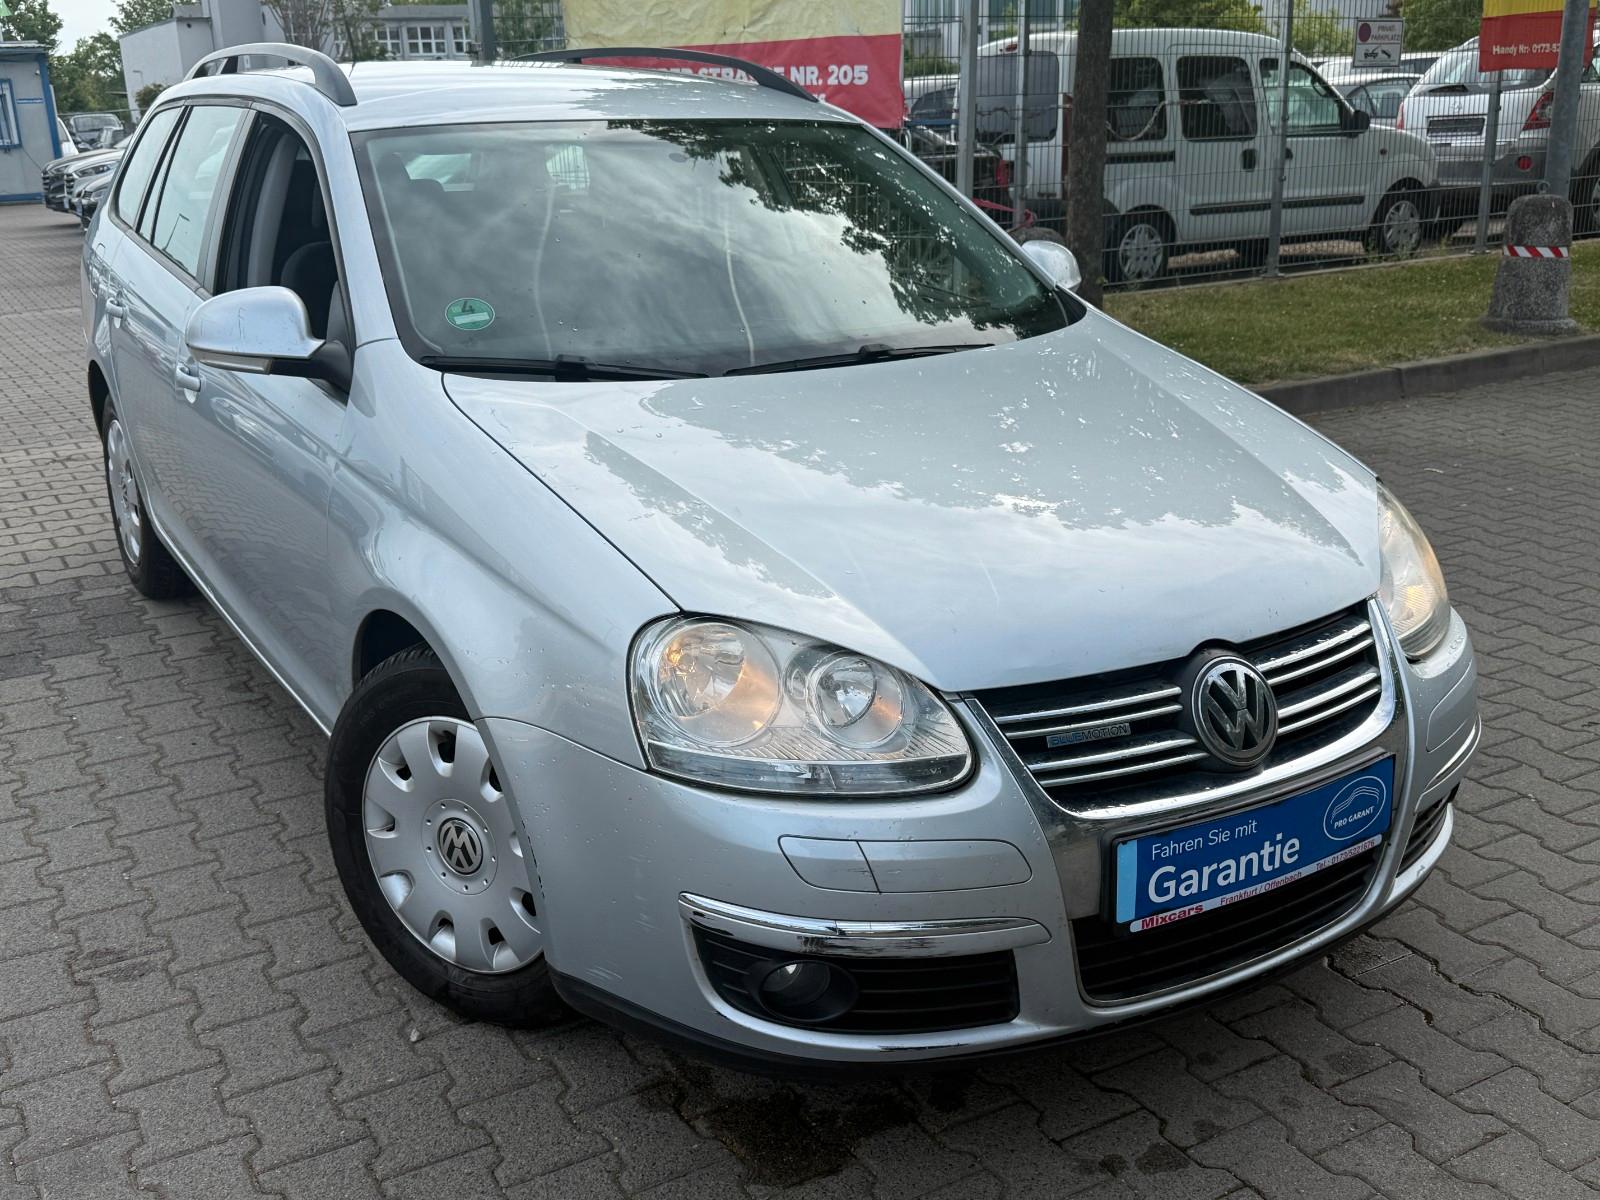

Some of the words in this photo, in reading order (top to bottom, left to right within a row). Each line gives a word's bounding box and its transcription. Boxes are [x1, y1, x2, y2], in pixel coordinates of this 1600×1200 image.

[1492, 44, 1517, 56] Handy
[1532, 43, 1560, 53] 0173-52
[790, 65, 823, 86] NR.
[827, 64, 869, 85] 205
[1199, 662, 1272, 760] VW
[1050, 723, 1128, 746] BLUEMOTION
[1334, 817, 1348, 830] PRO
[1348, 805, 1375, 823] GARANT
[1152, 837, 1203, 861] Fahren
[1208, 828, 1231, 846] Sie
[1235, 819, 1258, 839] mit
[1148, 832, 1300, 904] Garantie
[1141, 903, 1204, 931] Mixcars
[1220, 887, 1258, 906] Frankfurt
[1264, 872, 1302, 892] Offenbach
